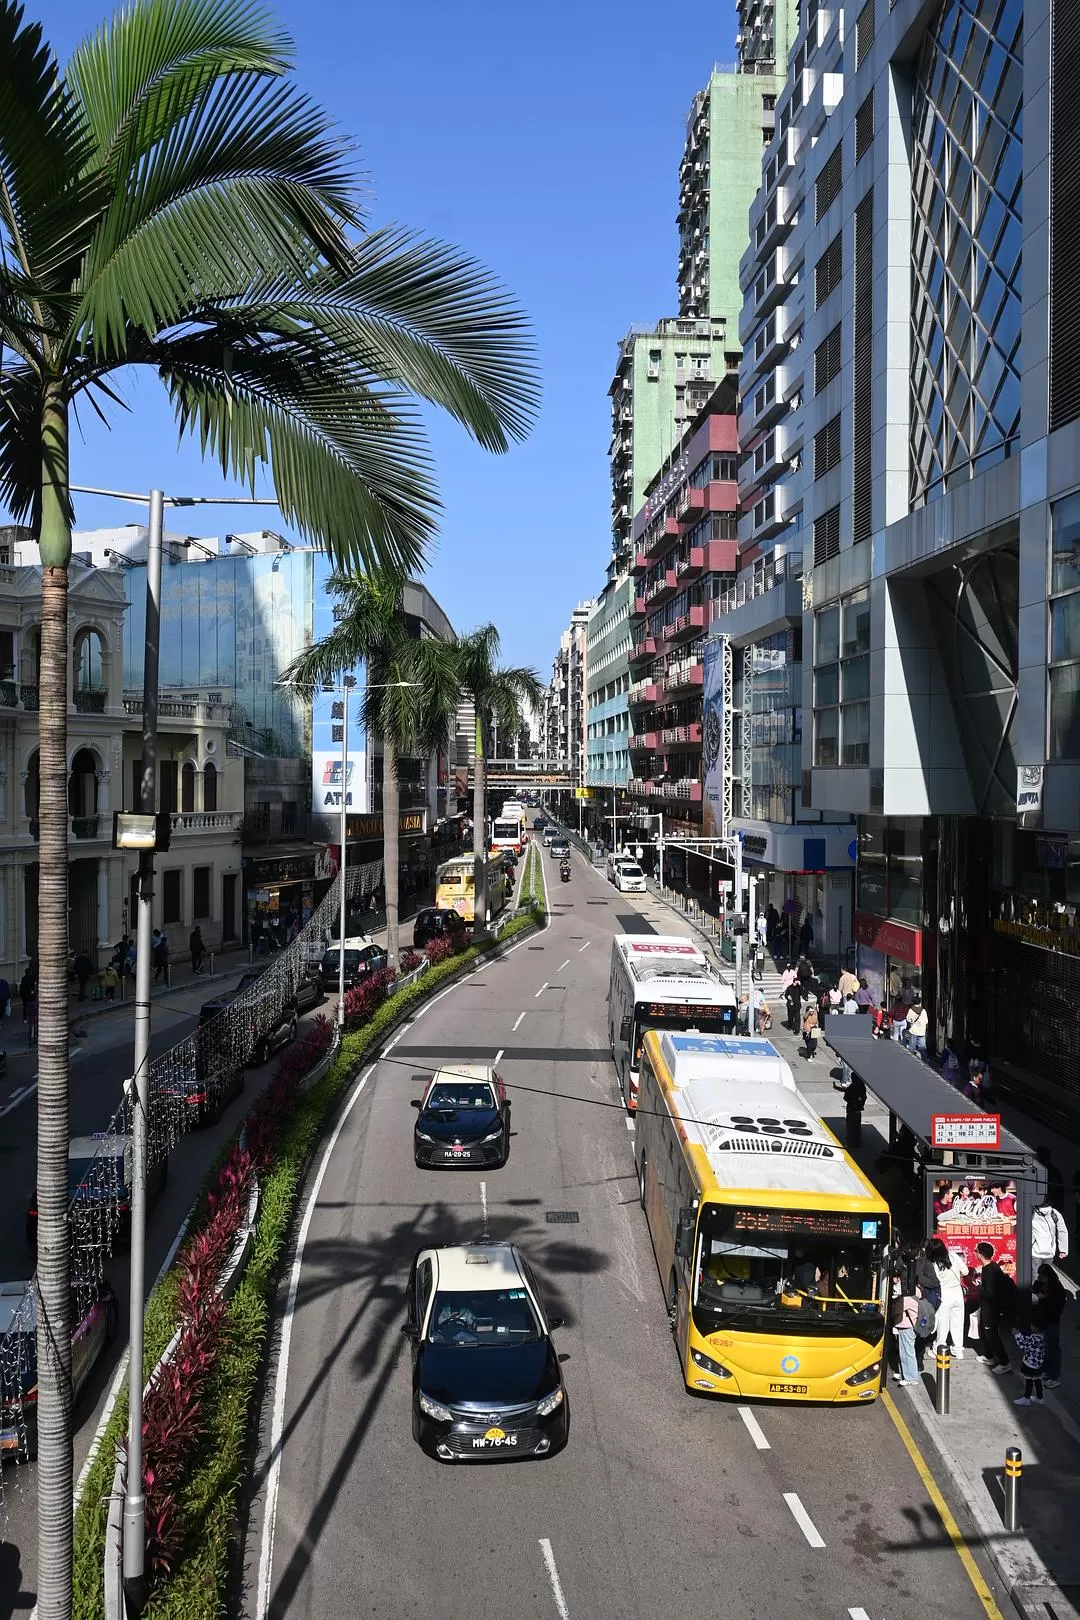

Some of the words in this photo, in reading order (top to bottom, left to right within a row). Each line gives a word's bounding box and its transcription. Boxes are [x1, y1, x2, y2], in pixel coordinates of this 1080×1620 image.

[324, 791, 352, 805] ATM
[649, 1003, 665, 1016] 22
[734, 1211, 770, 1231] 25B
[709, 1337, 734, 1348] HE267
[770, 1385, 807, 1393] AB-53-89
